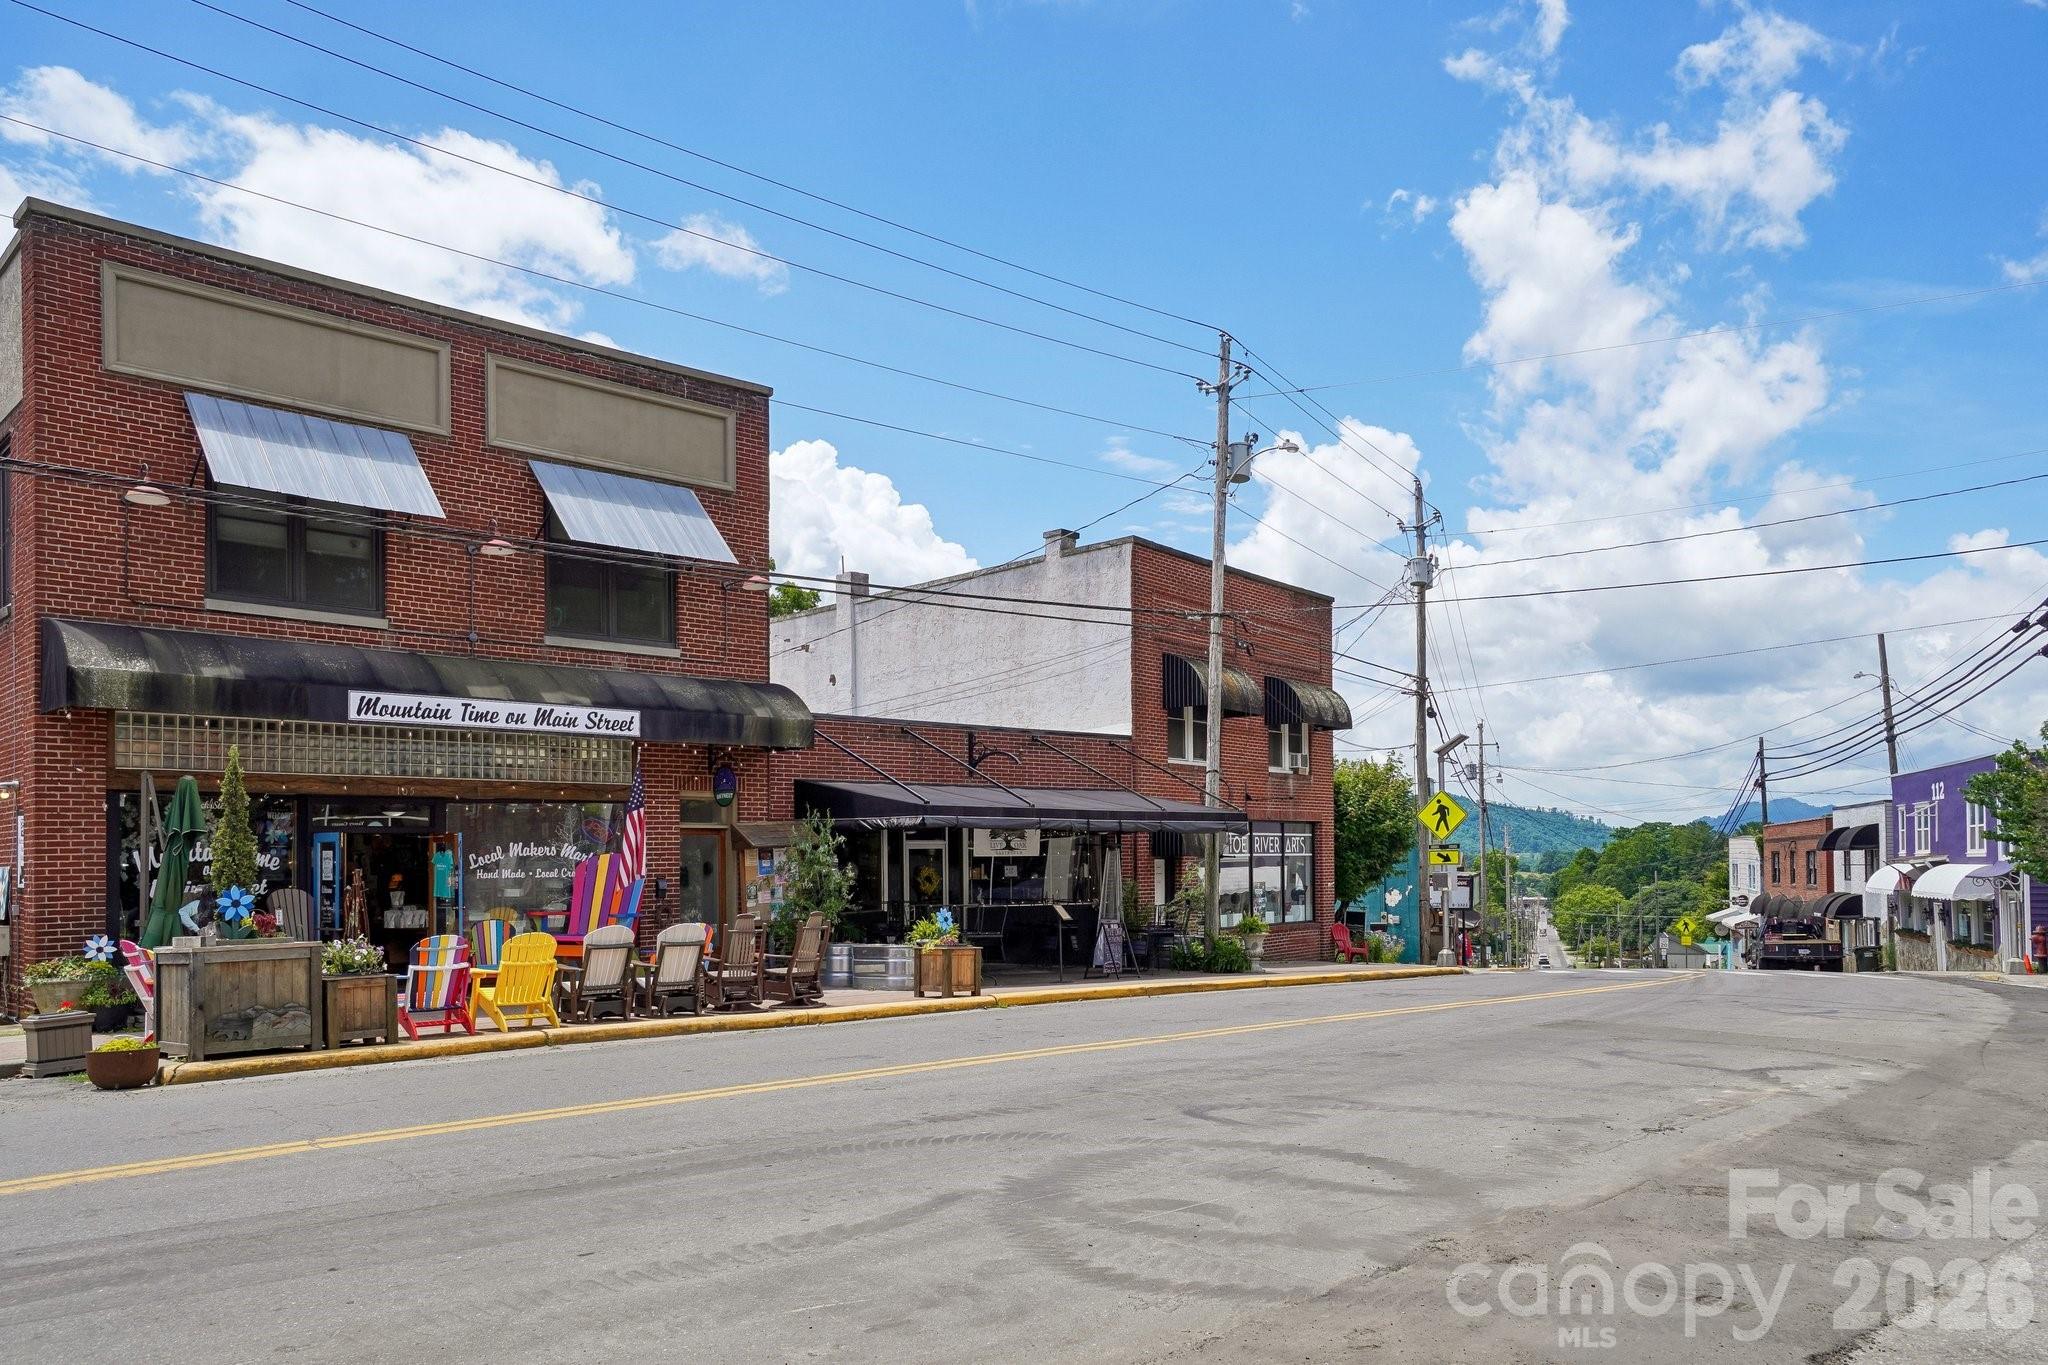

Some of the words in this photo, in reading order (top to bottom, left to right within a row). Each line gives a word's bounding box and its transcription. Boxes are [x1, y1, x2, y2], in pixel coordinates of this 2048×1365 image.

[356, 695, 452, 722] Mountain
[460, 702, 500, 724] Time
[505, 711, 527, 725] on
[533, 707, 579, 729] Main
[584, 711, 635, 732] Street
[1931, 781, 1945, 801] 112
[990, 841, 1004, 849] LIVE
[1229, 836, 1248, 853] TOE
[1254, 837, 1280, 853] RIVER
[1285, 837, 1306, 854] ARTS
[468, 845, 505, 870] Local
[509, 842, 557, 858] Makers
[560, 842, 594, 862] Mar
[476, 869, 499, 879] Hand
[502, 868, 526, 879] Made
[535, 868, 559, 879] Local
[561, 868, 576, 878] Cra
